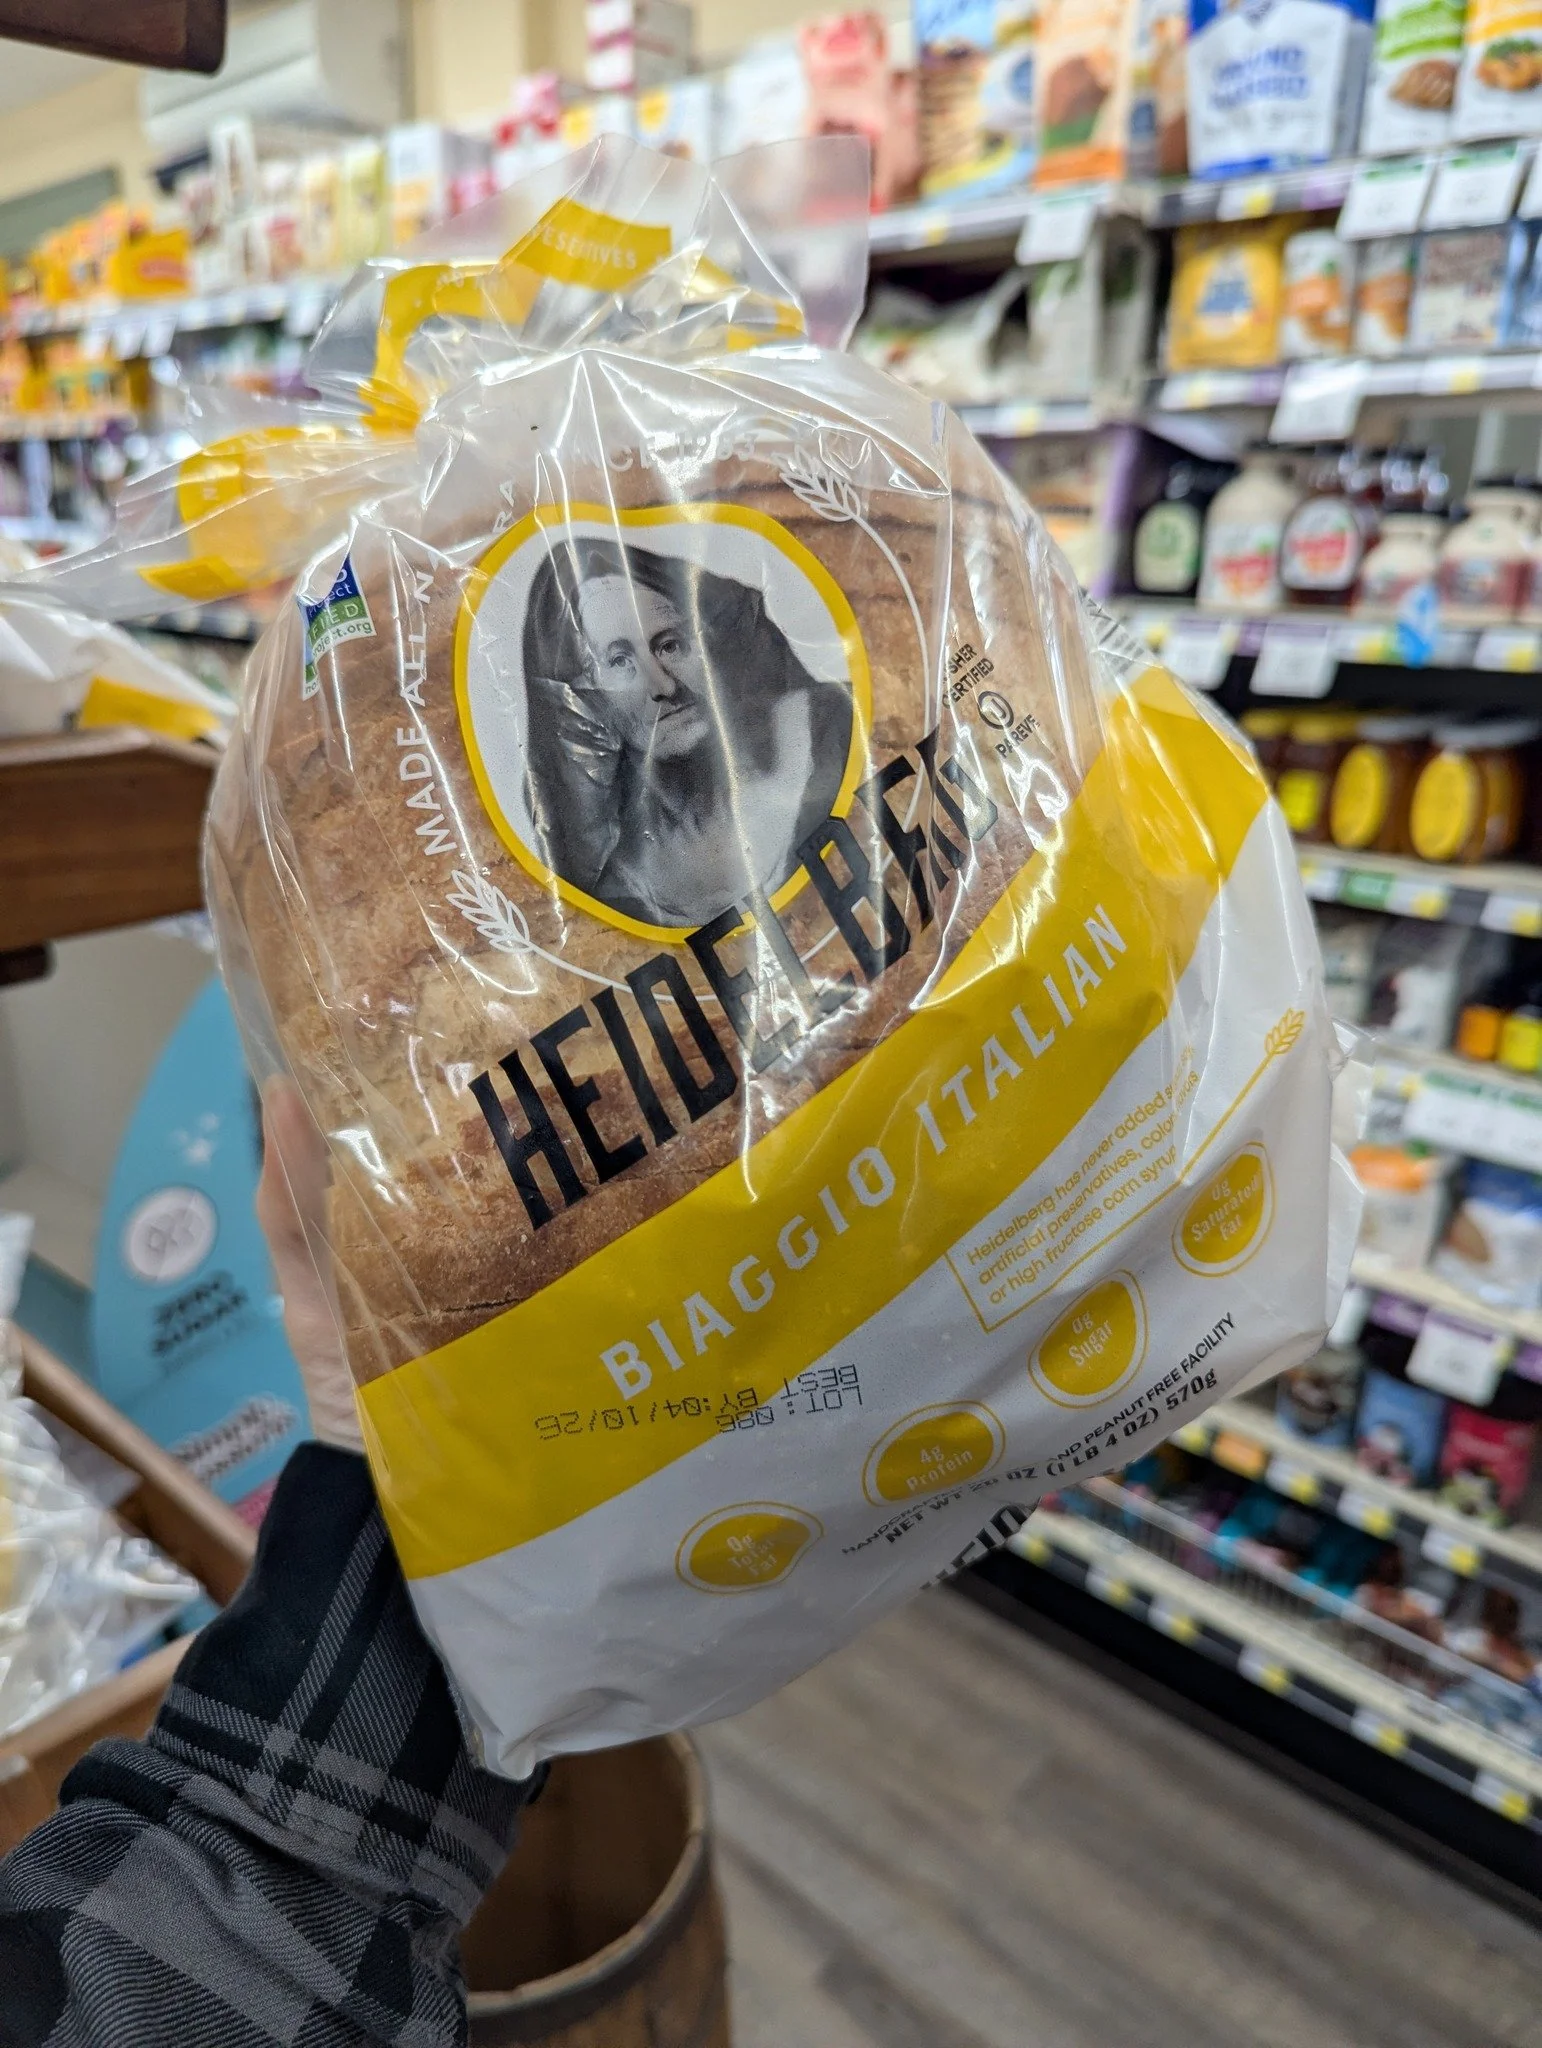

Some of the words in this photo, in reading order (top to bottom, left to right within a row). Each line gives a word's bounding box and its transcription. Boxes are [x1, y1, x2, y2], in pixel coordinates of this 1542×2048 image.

[402, 619, 428, 708] ALL
[942, 657, 995, 709] CERTIFIED
[995, 714, 1040, 759] PAREVE
[396, 726, 458, 858] MADE
[600, 1147, 897, 1400] BIAGGIO
[915, 904, 1127, 1155] ITALIAN
[967, 1195, 1056, 1266] Heidelberg
[1055, 1170, 1082, 1200] has
[1081, 1137, 1114, 1177] never
[1114, 1091, 1167, 1140] added
[979, 1226, 1044, 1285] artificial
[1048, 1146, 1143, 1239] preservatives,
[990, 1286, 1007, 1304] or
[1006, 1257, 1046, 1291] high
[1045, 1206, 1102, 1264] fructose
[1102, 1177, 1143, 1212] corn
[1191, 1174, 1261, 1242] Saturated
[1221, 1213, 1243, 1241] Fat
[780, 1364, 859, 1399] BEST
[1069, 1320, 1114, 1367] Sugar
[1048, 1442, 1082, 1462] ND
[1084, 1396, 1145, 1444] PEANUT
[1147, 1368, 1183, 1402] FREE
[1180, 1312, 1237, 1375] FACILITY
[885, 1509, 925, 1545] NET
[929, 1490, 964, 1511] WT
[1073, 1446, 1099, 1467] LB
[1105, 1432, 1118, 1448] 4
[1123, 1407, 1159, 1438] OZ)
[1165, 1367, 1218, 1411] 570g
[906, 1450, 973, 1491] Protein
[921, 1445, 944, 1465] 4g
